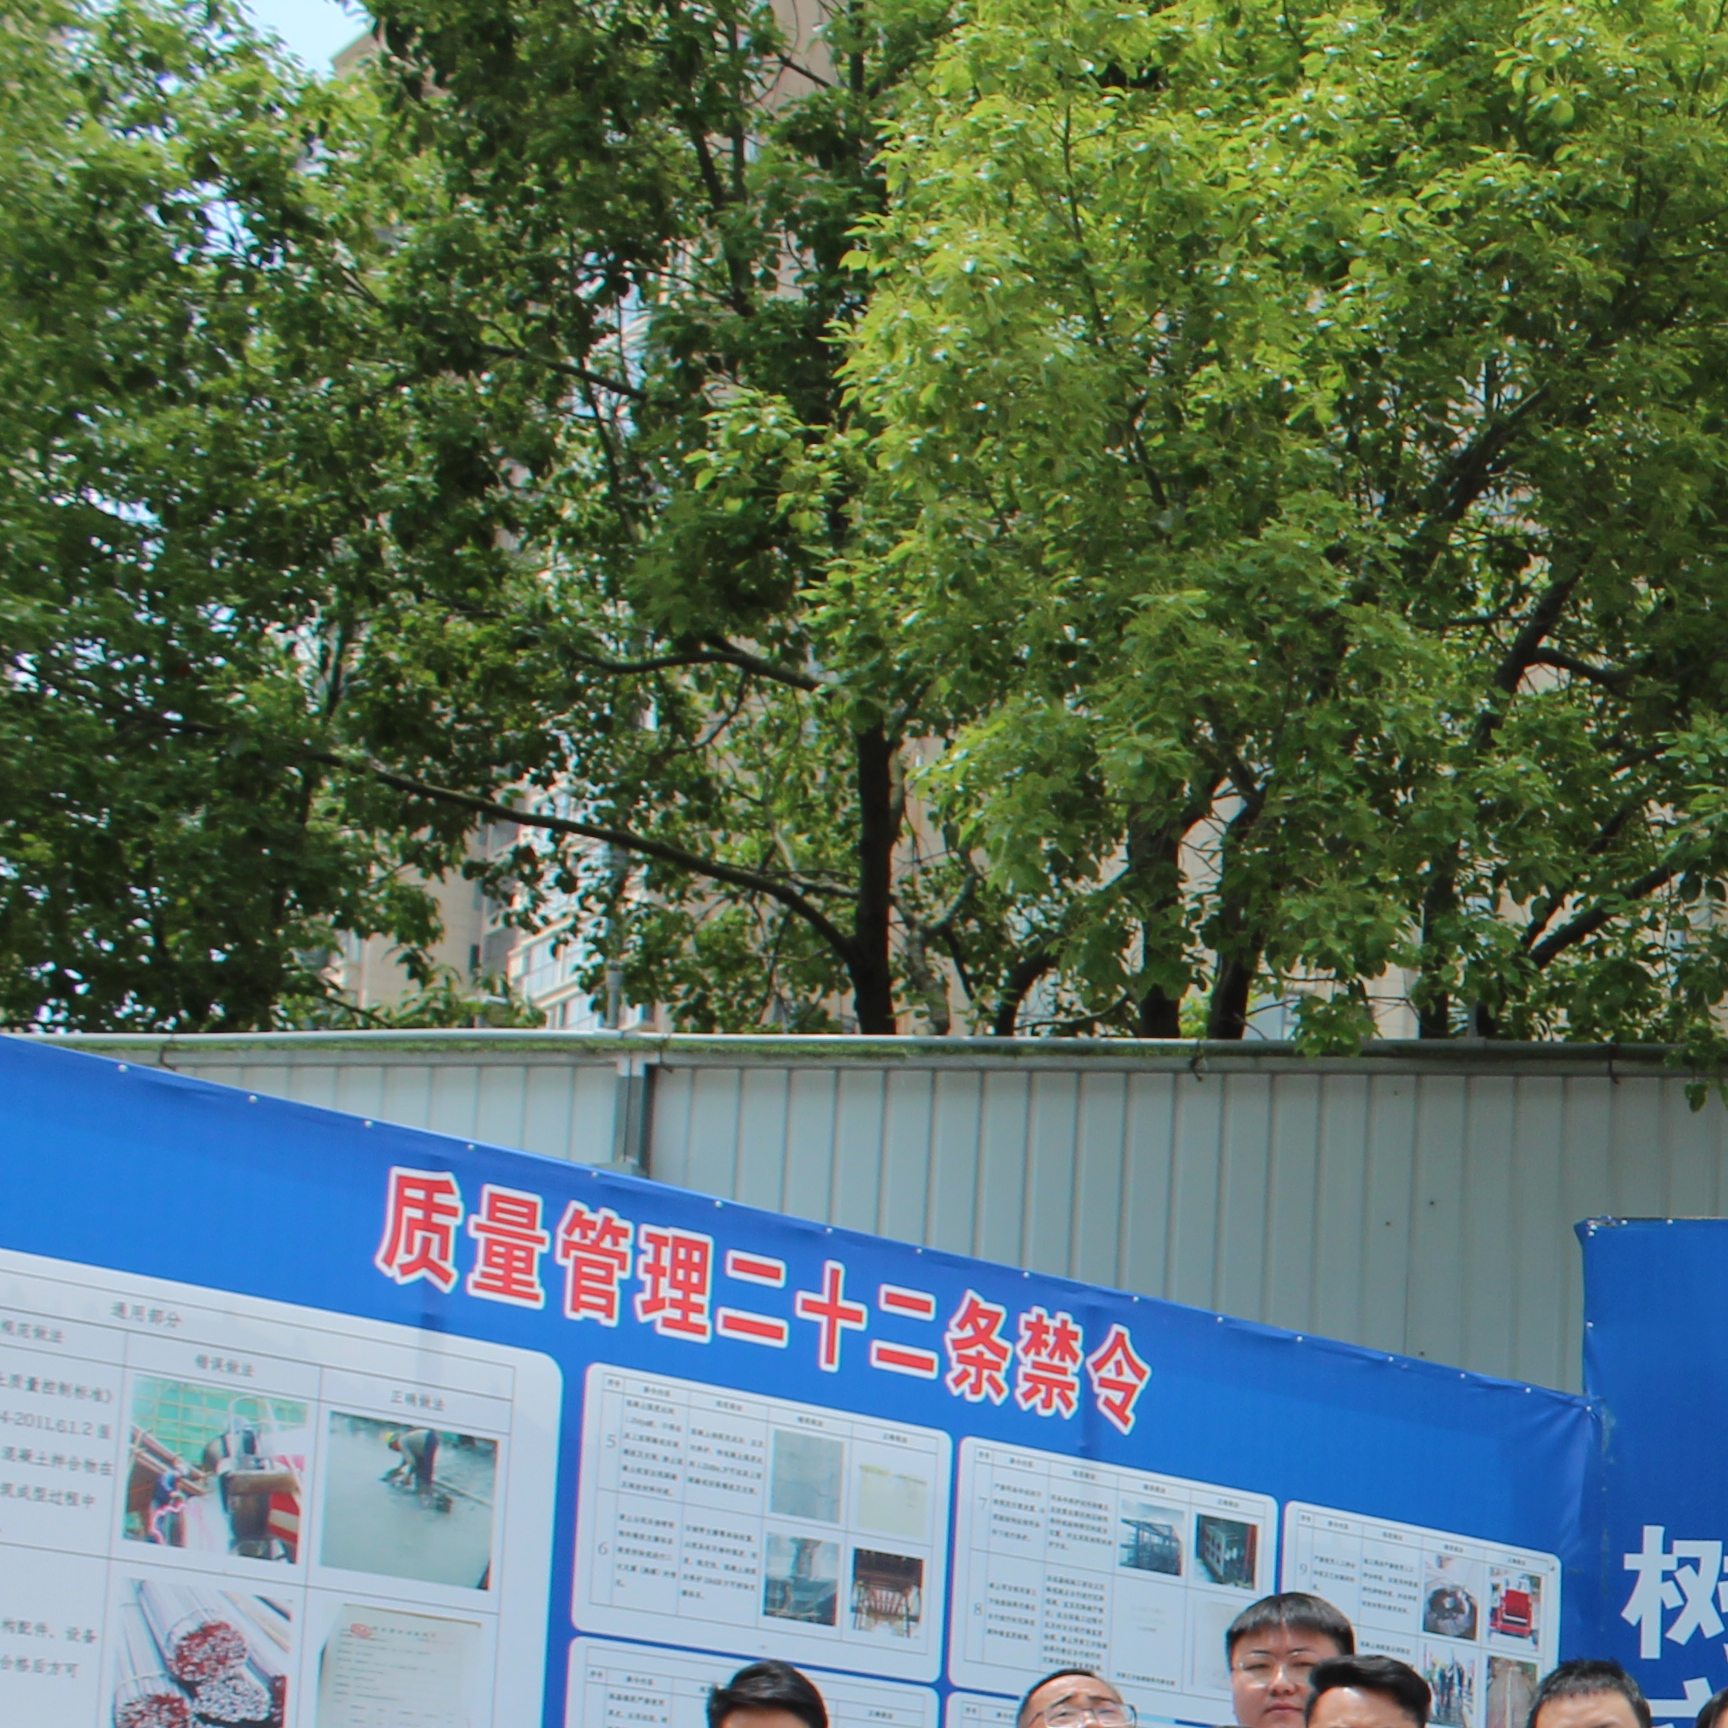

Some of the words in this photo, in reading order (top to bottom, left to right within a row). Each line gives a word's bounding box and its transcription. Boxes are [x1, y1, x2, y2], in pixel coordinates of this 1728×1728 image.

[374, 1165, 1151, 1434] 质量管理二十二条禁令
